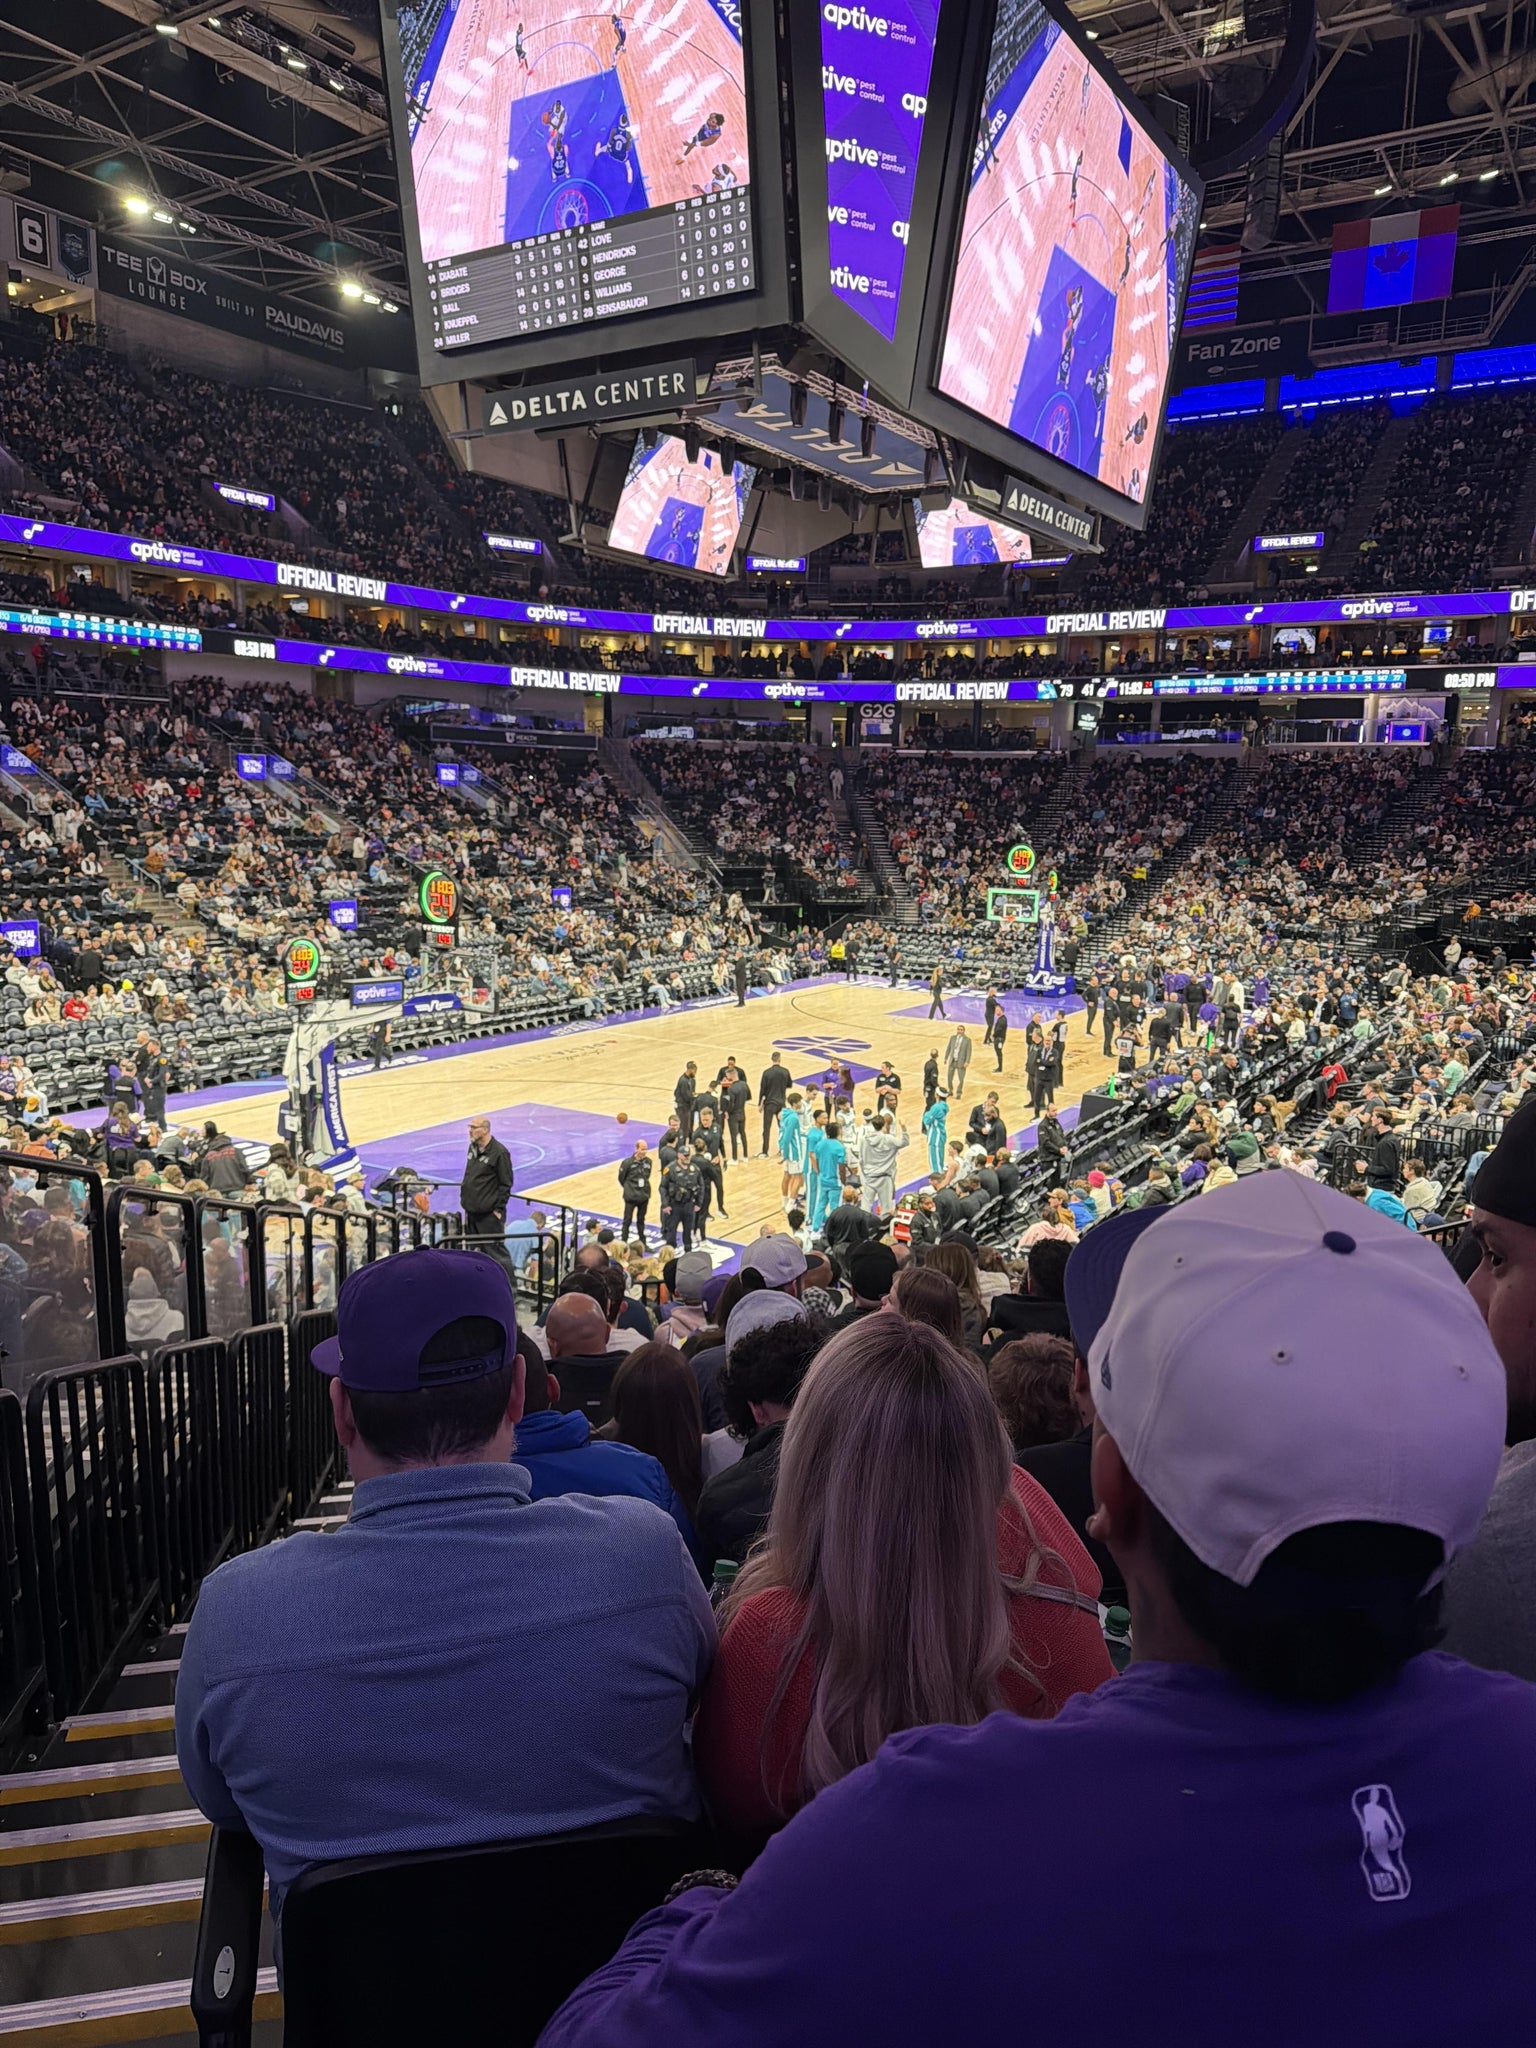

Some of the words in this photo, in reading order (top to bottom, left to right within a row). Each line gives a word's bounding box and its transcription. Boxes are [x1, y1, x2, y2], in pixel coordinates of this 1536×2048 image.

[824, 3, 888, 37] aptive
[891, 21, 907, 33] pest
[890, 31, 916, 45] control
[860, 80, 876, 91] pest
[859, 89, 885, 103] control
[1029, 100, 1052, 143] CENTER
[881, 152, 897, 163] pest
[881, 161, 906, 175] control
[851, 209, 867, 220] pest
[578, 239, 588, 249] 42
[591, 233, 612, 247] LOVE
[678, 215, 685, 226] 2
[695, 212, 700, 222] 5
[709, 208, 715, 219] 0
[722, 205, 731, 216] 12
[739, 201, 745, 212] 2
[851, 218, 876, 232] control
[22, 217, 43, 254] 6
[581, 256, 587, 266] 0
[593, 246, 636, 264] HENDRICKS
[680, 233, 685, 244] 1
[695, 230, 701, 241] 0
[710, 227, 717, 238] 0
[723, 224, 732, 234] 13
[740, 220, 746, 231] 0
[102, 245, 142, 273] TEE
[170, 269, 208, 296] BOX
[428, 275, 436, 284] 14
[439, 267, 468, 282] DIABATE
[515, 255, 521, 264] 3
[529, 252, 534, 261] 5
[542, 249, 545, 258] 1
[567, 243, 572, 252] 1
[583, 273, 588, 283] 3
[594, 266, 626, 281] GEORGE
[680, 252, 687, 262] 4
[696, 249, 703, 259] 2
[711, 245, 717, 256] 3
[723, 242, 734, 254] 20
[741, 239, 746, 249] 1
[431, 290, 437, 300] 0
[441, 283, 470, 298] BRIDGES
[516, 272, 523, 281] 11
[542, 266, 548, 275] 3
[569, 260, 573, 269] 1
[595, 282, 632, 298] WILLIAMS
[682, 270, 688, 280] 6
[698, 267, 704, 277] 0
[712, 263, 719, 274] 0
[725, 260, 734, 271] 15
[742, 257, 748, 268] 0
[873, 278, 888, 289] pest
[129, 278, 187, 311] LOUNGE
[433, 307, 437, 316] 1
[442, 302, 460, 314] BALL
[516, 288, 525, 297] 14
[531, 285, 537, 294] 4
[543, 282, 549, 292] 3
[570, 277, 575, 286] 1
[597, 296, 648, 315] SENSABAUGH
[681, 287, 690, 298] 14
[699, 285, 705, 295] 2
[713, 281, 720, 292] 0
[726, 278, 735, 289] 15
[742, 275, 749, 286] 0
[872, 286, 896, 300] control
[434, 322, 439, 331] 7
[518, 304, 526, 314] 12
[533, 301, 539, 311] 0
[572, 294, 576, 303] 1
[265, 305, 344, 346] PAUDAVIS
[446, 332, 470, 345] MILLER
[519, 321, 528, 330] 14
[534, 318, 540, 328] 3
[546, 315, 552, 325] 4
[572, 310, 578, 320] 2
[1187, 343, 1225, 362] Fan
[1229, 336, 1281, 356] Zone
[512, 392, 587, 420] DELTA
[595, 372, 686, 407] CENTER
[1018, 497, 1053, 524] DELTA
[1054, 506, 1091, 541] CENTER
[487, 536, 513, 548] OFFICIAL
[513, 539, 535, 551] REVIEW
[1261, 536, 1290, 547] OFFICIAL
[1290, 535, 1317, 546] REVIEW
[130, 542, 181, 563] aptive
[752, 558, 776, 569] OFFICIAL
[277, 563, 336, 593] OFFICIAL
[337, 574, 387, 601] REVIEW
[526, 605, 568, 622] aptive
[1341, 599, 1394, 618] aptive
[1395, 605, 1418, 613] control
[1396, 600, 1410, 608] pest
[653, 615, 711, 635] OFFICIAL
[714, 617, 766, 637] REVIEW
[916, 620, 958, 639] aptive
[1046, 613, 1107, 634] OFFICIAL
[1109, 609, 1166, 630] REVIEW
[260, 643, 275, 659] PM
[387, 656, 427, 673] aptive
[511, 667, 568, 689] OFFICIAL
[569, 673, 621, 692] REVIEW
[1444, 673, 1474, 688] 08:50
[1476, 673, 1496, 687] PM
[764, 682, 806, 699] aptive
[896, 683, 954, 701] OFFICIAL
[956, 682, 1009, 700] REVIEW
[1060, 684, 1073, 697] 79
[1081, 683, 1095, 696] 41
[860, 703, 896, 718] G2G
[429, 893, 453, 918] 24
[291, 960, 310, 975] 24
[356, 985, 387, 1001] aptive
[326, 1062, 337, 1094] FIRST
[326, 1095, 346, 1142] AMERICA
